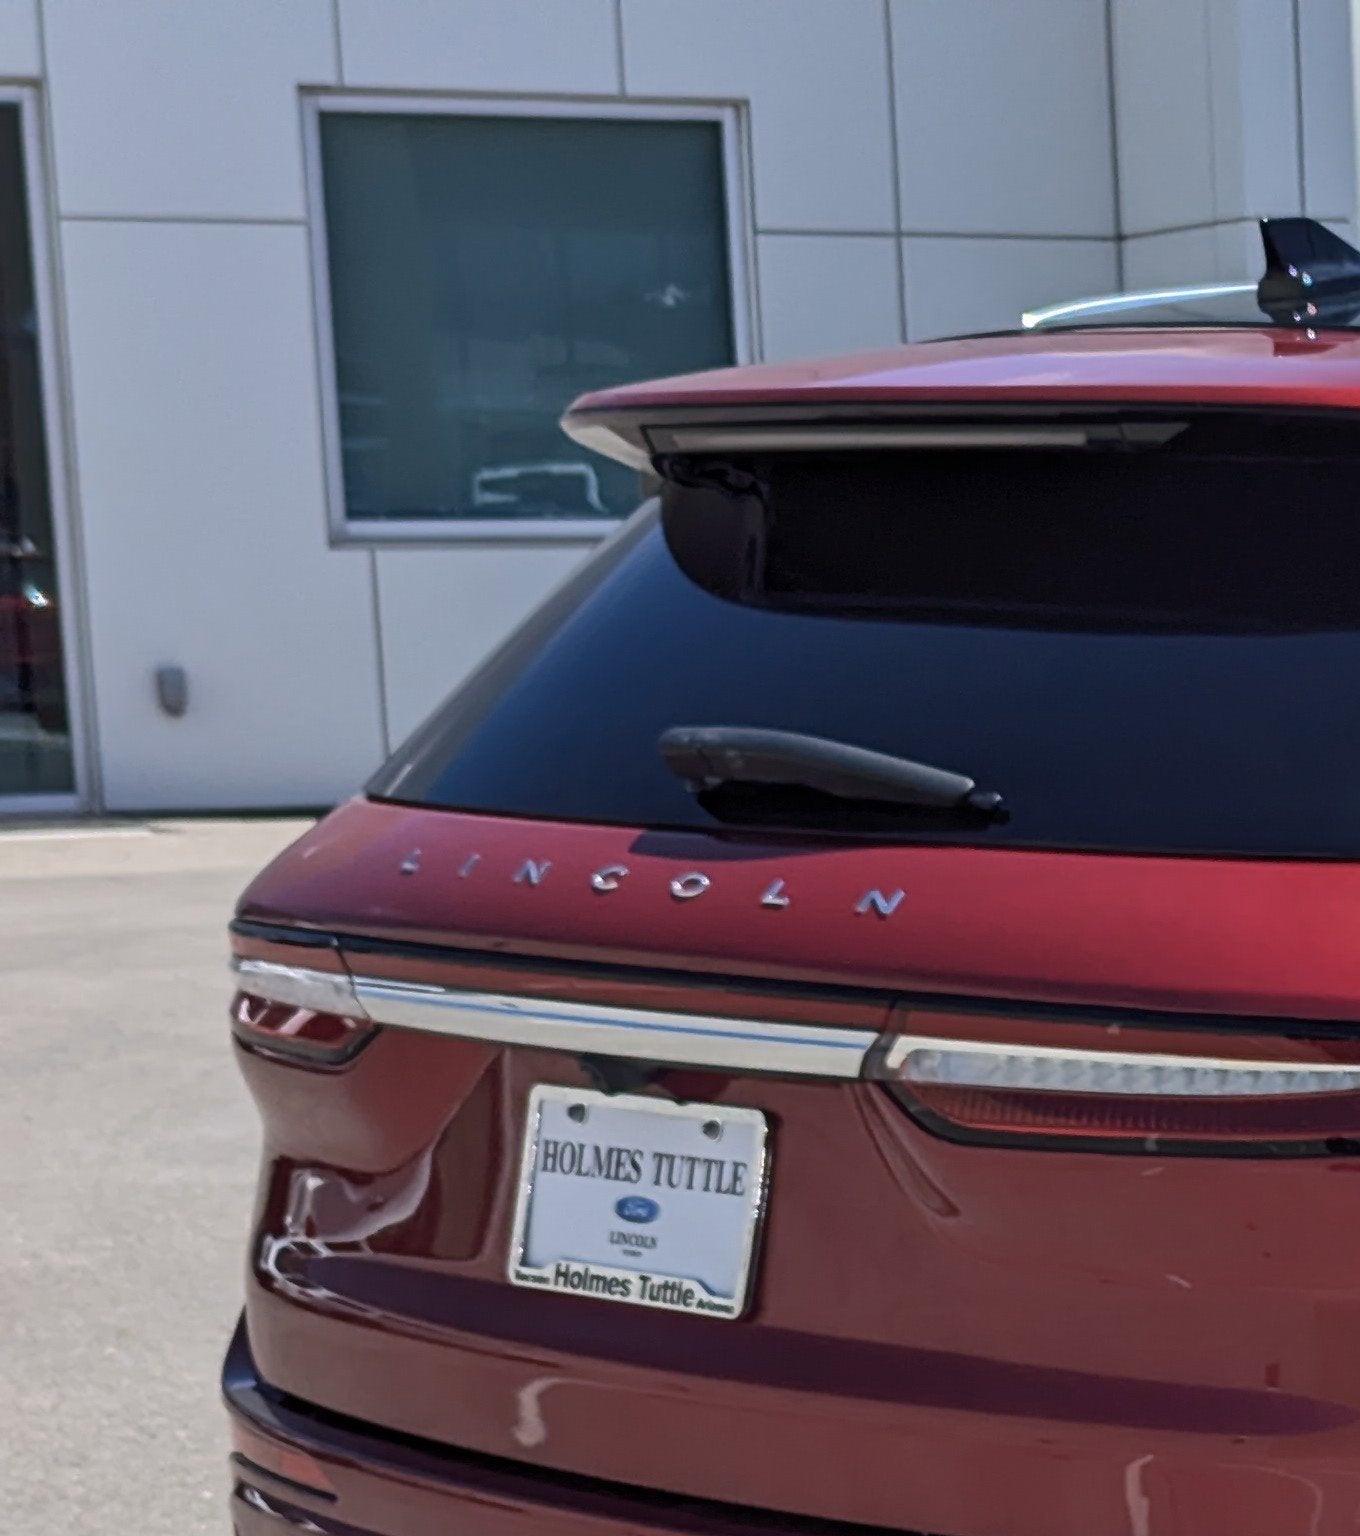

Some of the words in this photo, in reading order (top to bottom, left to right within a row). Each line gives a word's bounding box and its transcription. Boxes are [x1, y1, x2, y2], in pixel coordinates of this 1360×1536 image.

[401, 848, 905, 918] LINCOLN
[541, 1139, 643, 1183] HOLMES
[653, 1151, 748, 1196] TUTTLE
[554, 1262, 632, 1298] Holmes
[638, 1275, 696, 1308] Tuttle
